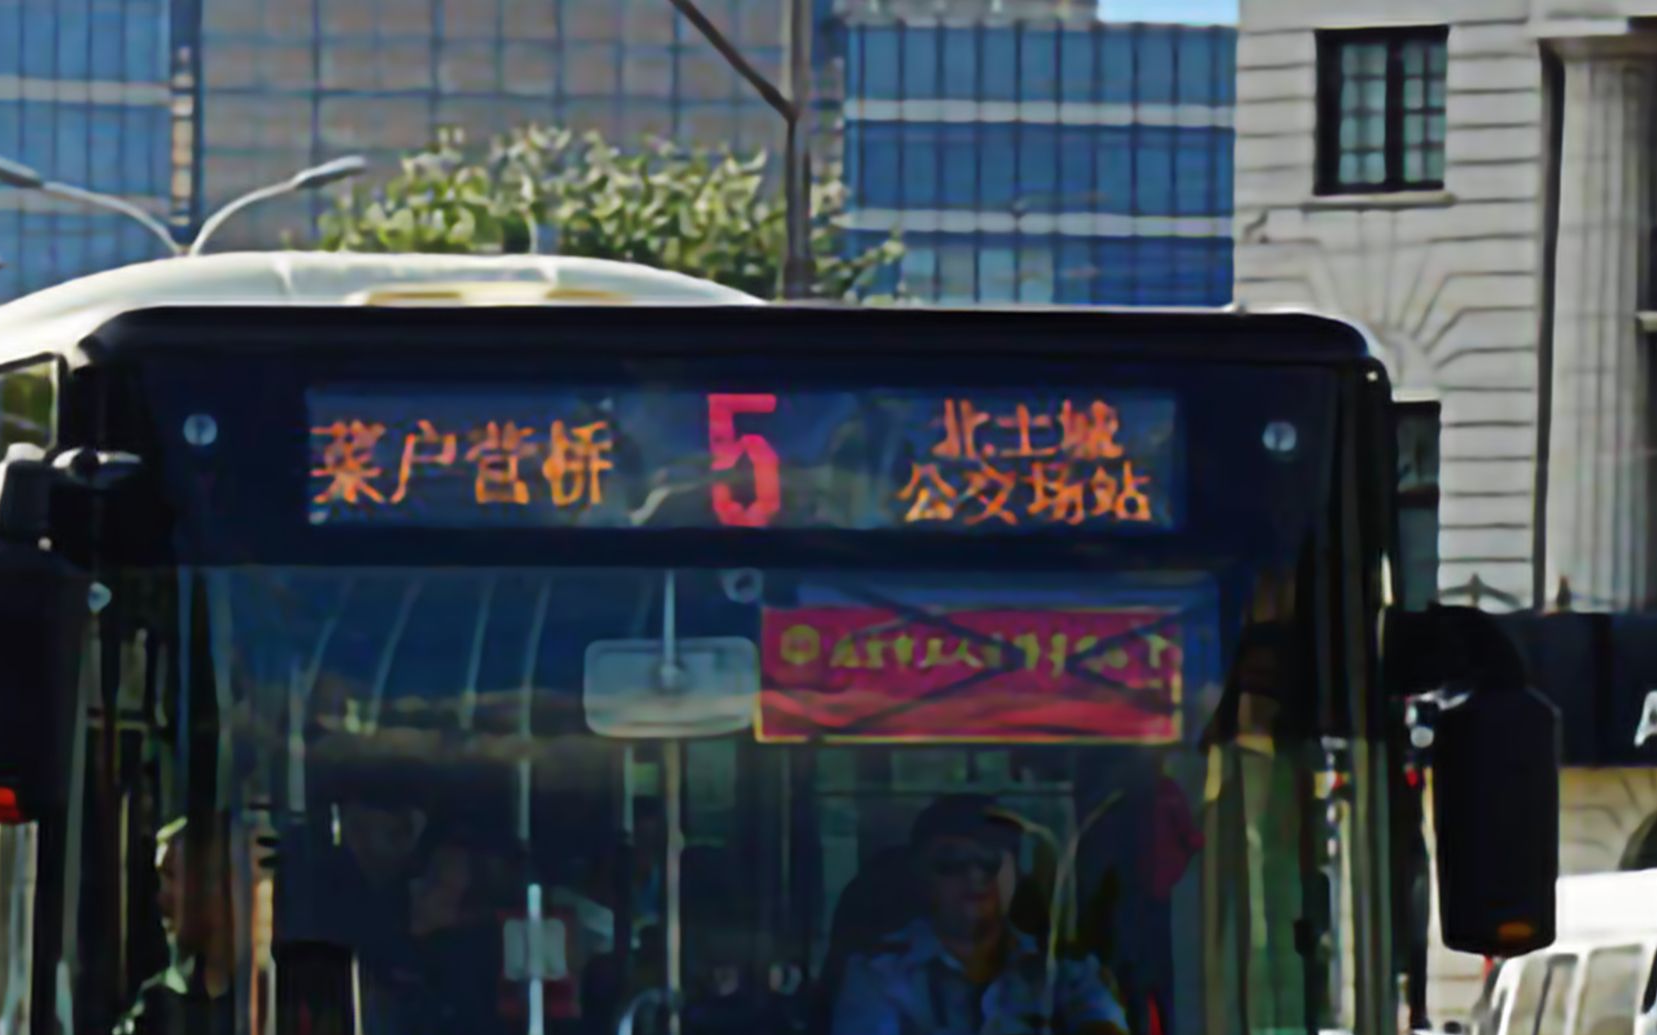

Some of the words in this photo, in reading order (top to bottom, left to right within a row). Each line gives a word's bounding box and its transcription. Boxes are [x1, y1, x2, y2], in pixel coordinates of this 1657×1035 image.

[310, 418, 615, 507] 菜户营桥
[708, 392, 781, 526] 5
[930, 398, 1124, 461] 北土城
[897, 460, 1152, 525] 公交场站
